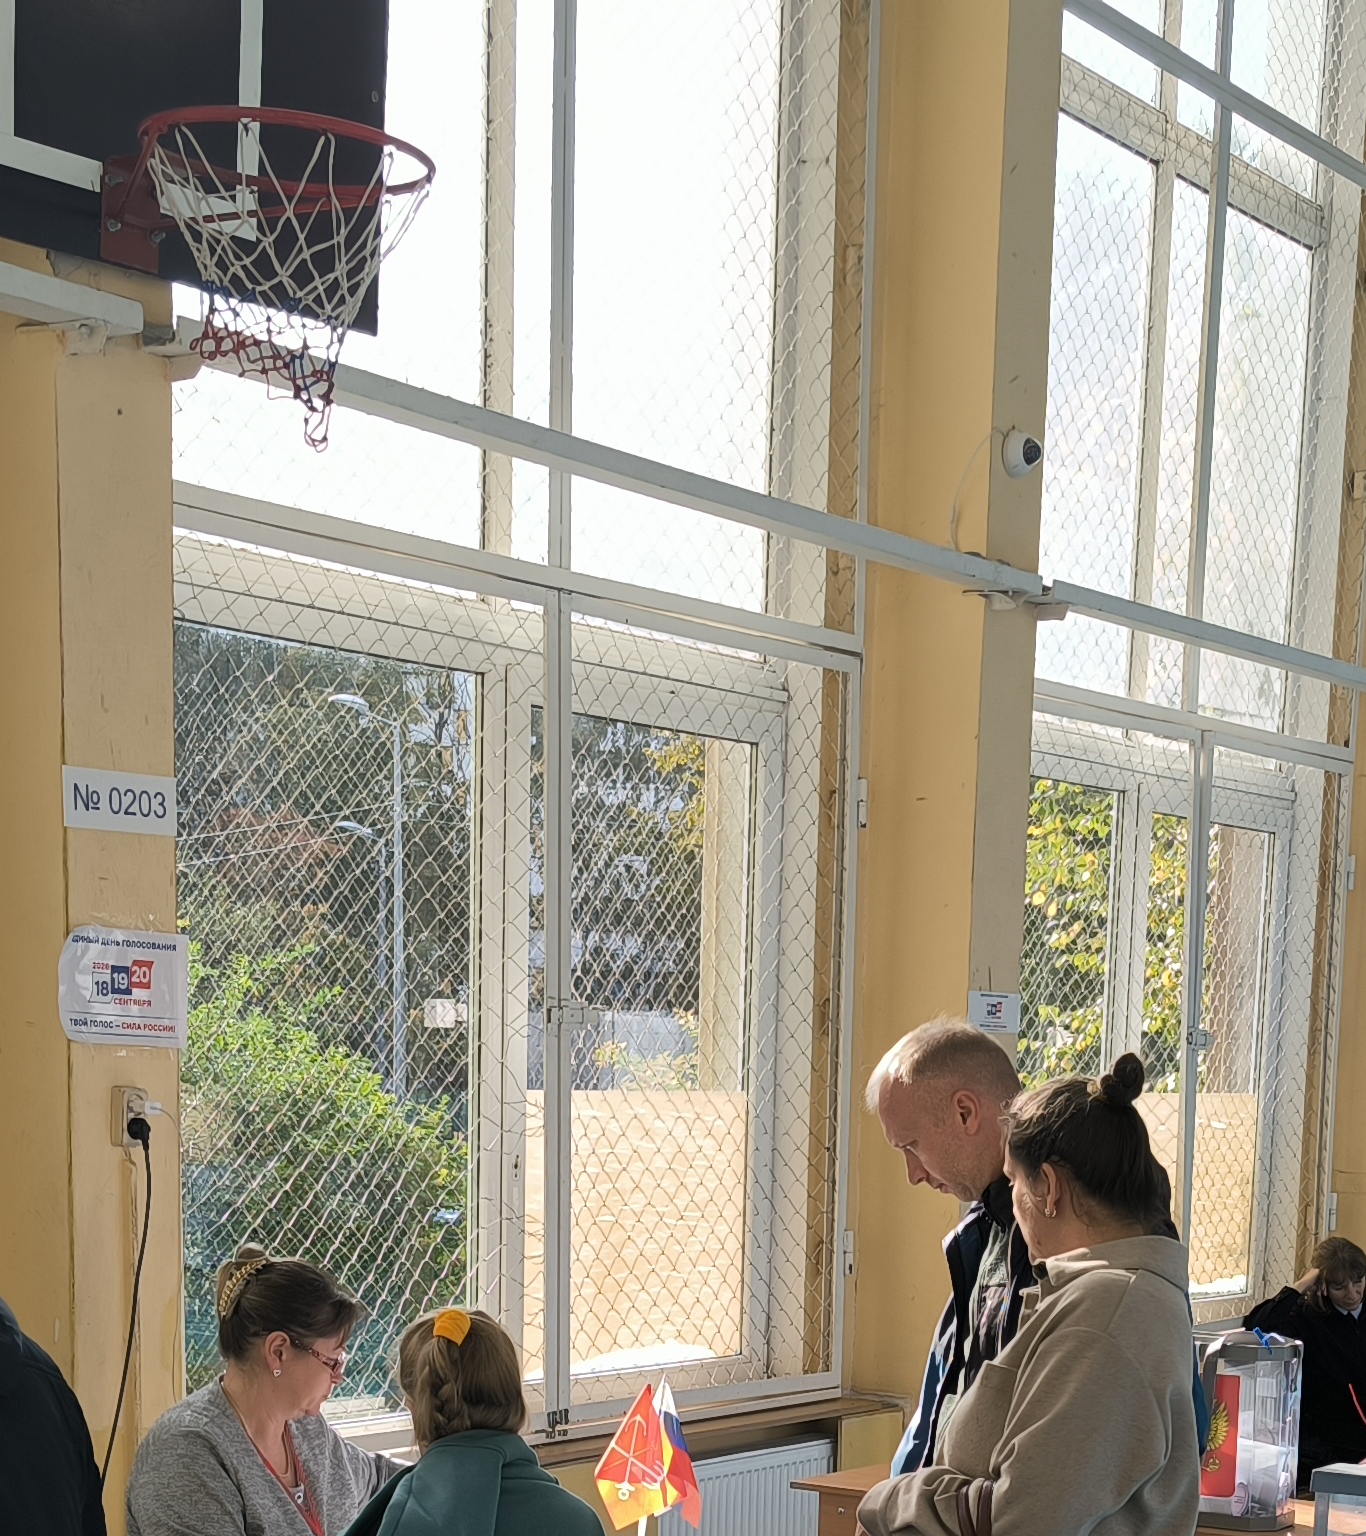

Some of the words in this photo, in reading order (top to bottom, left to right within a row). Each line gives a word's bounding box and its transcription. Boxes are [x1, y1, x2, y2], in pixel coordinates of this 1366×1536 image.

[73, 782, 101, 812] №
[108, 786, 167, 819] 0203
[100, 937, 121, 948] ДЕНЬ
[121, 939, 177, 952] ГОЛОСОВАНИЯ
[94, 980, 110, 997] 18
[113, 972, 129, 990] 19
[131, 966, 150, 984] 20
[69, 1017, 89, 1028] ТВОЙ
[89, 1019, 114, 1030] ГОЛОС
[121, 1021, 142, 1032] СИЛА
